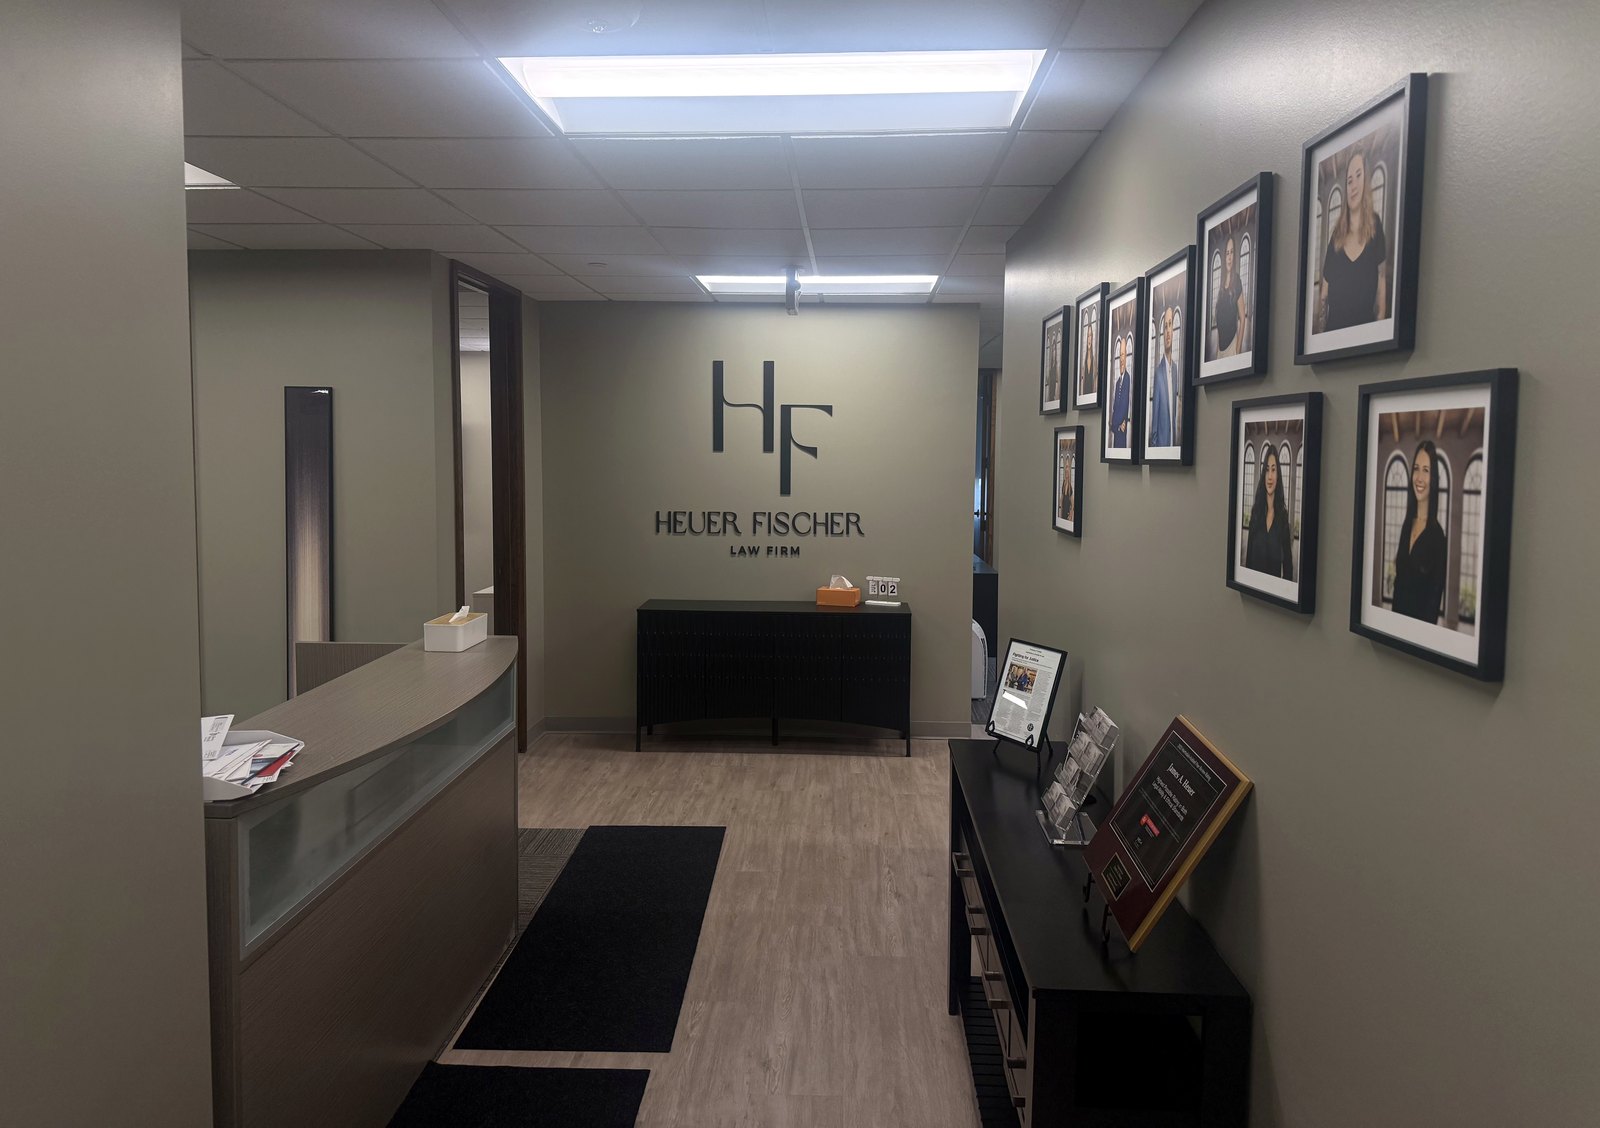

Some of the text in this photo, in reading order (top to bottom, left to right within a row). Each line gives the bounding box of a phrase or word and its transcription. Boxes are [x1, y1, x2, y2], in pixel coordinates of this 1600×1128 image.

[712, 360, 832, 497] HF
[655, 511, 865, 537] HEUER FISCHER
[730, 546, 800, 557] LAW FIRM
